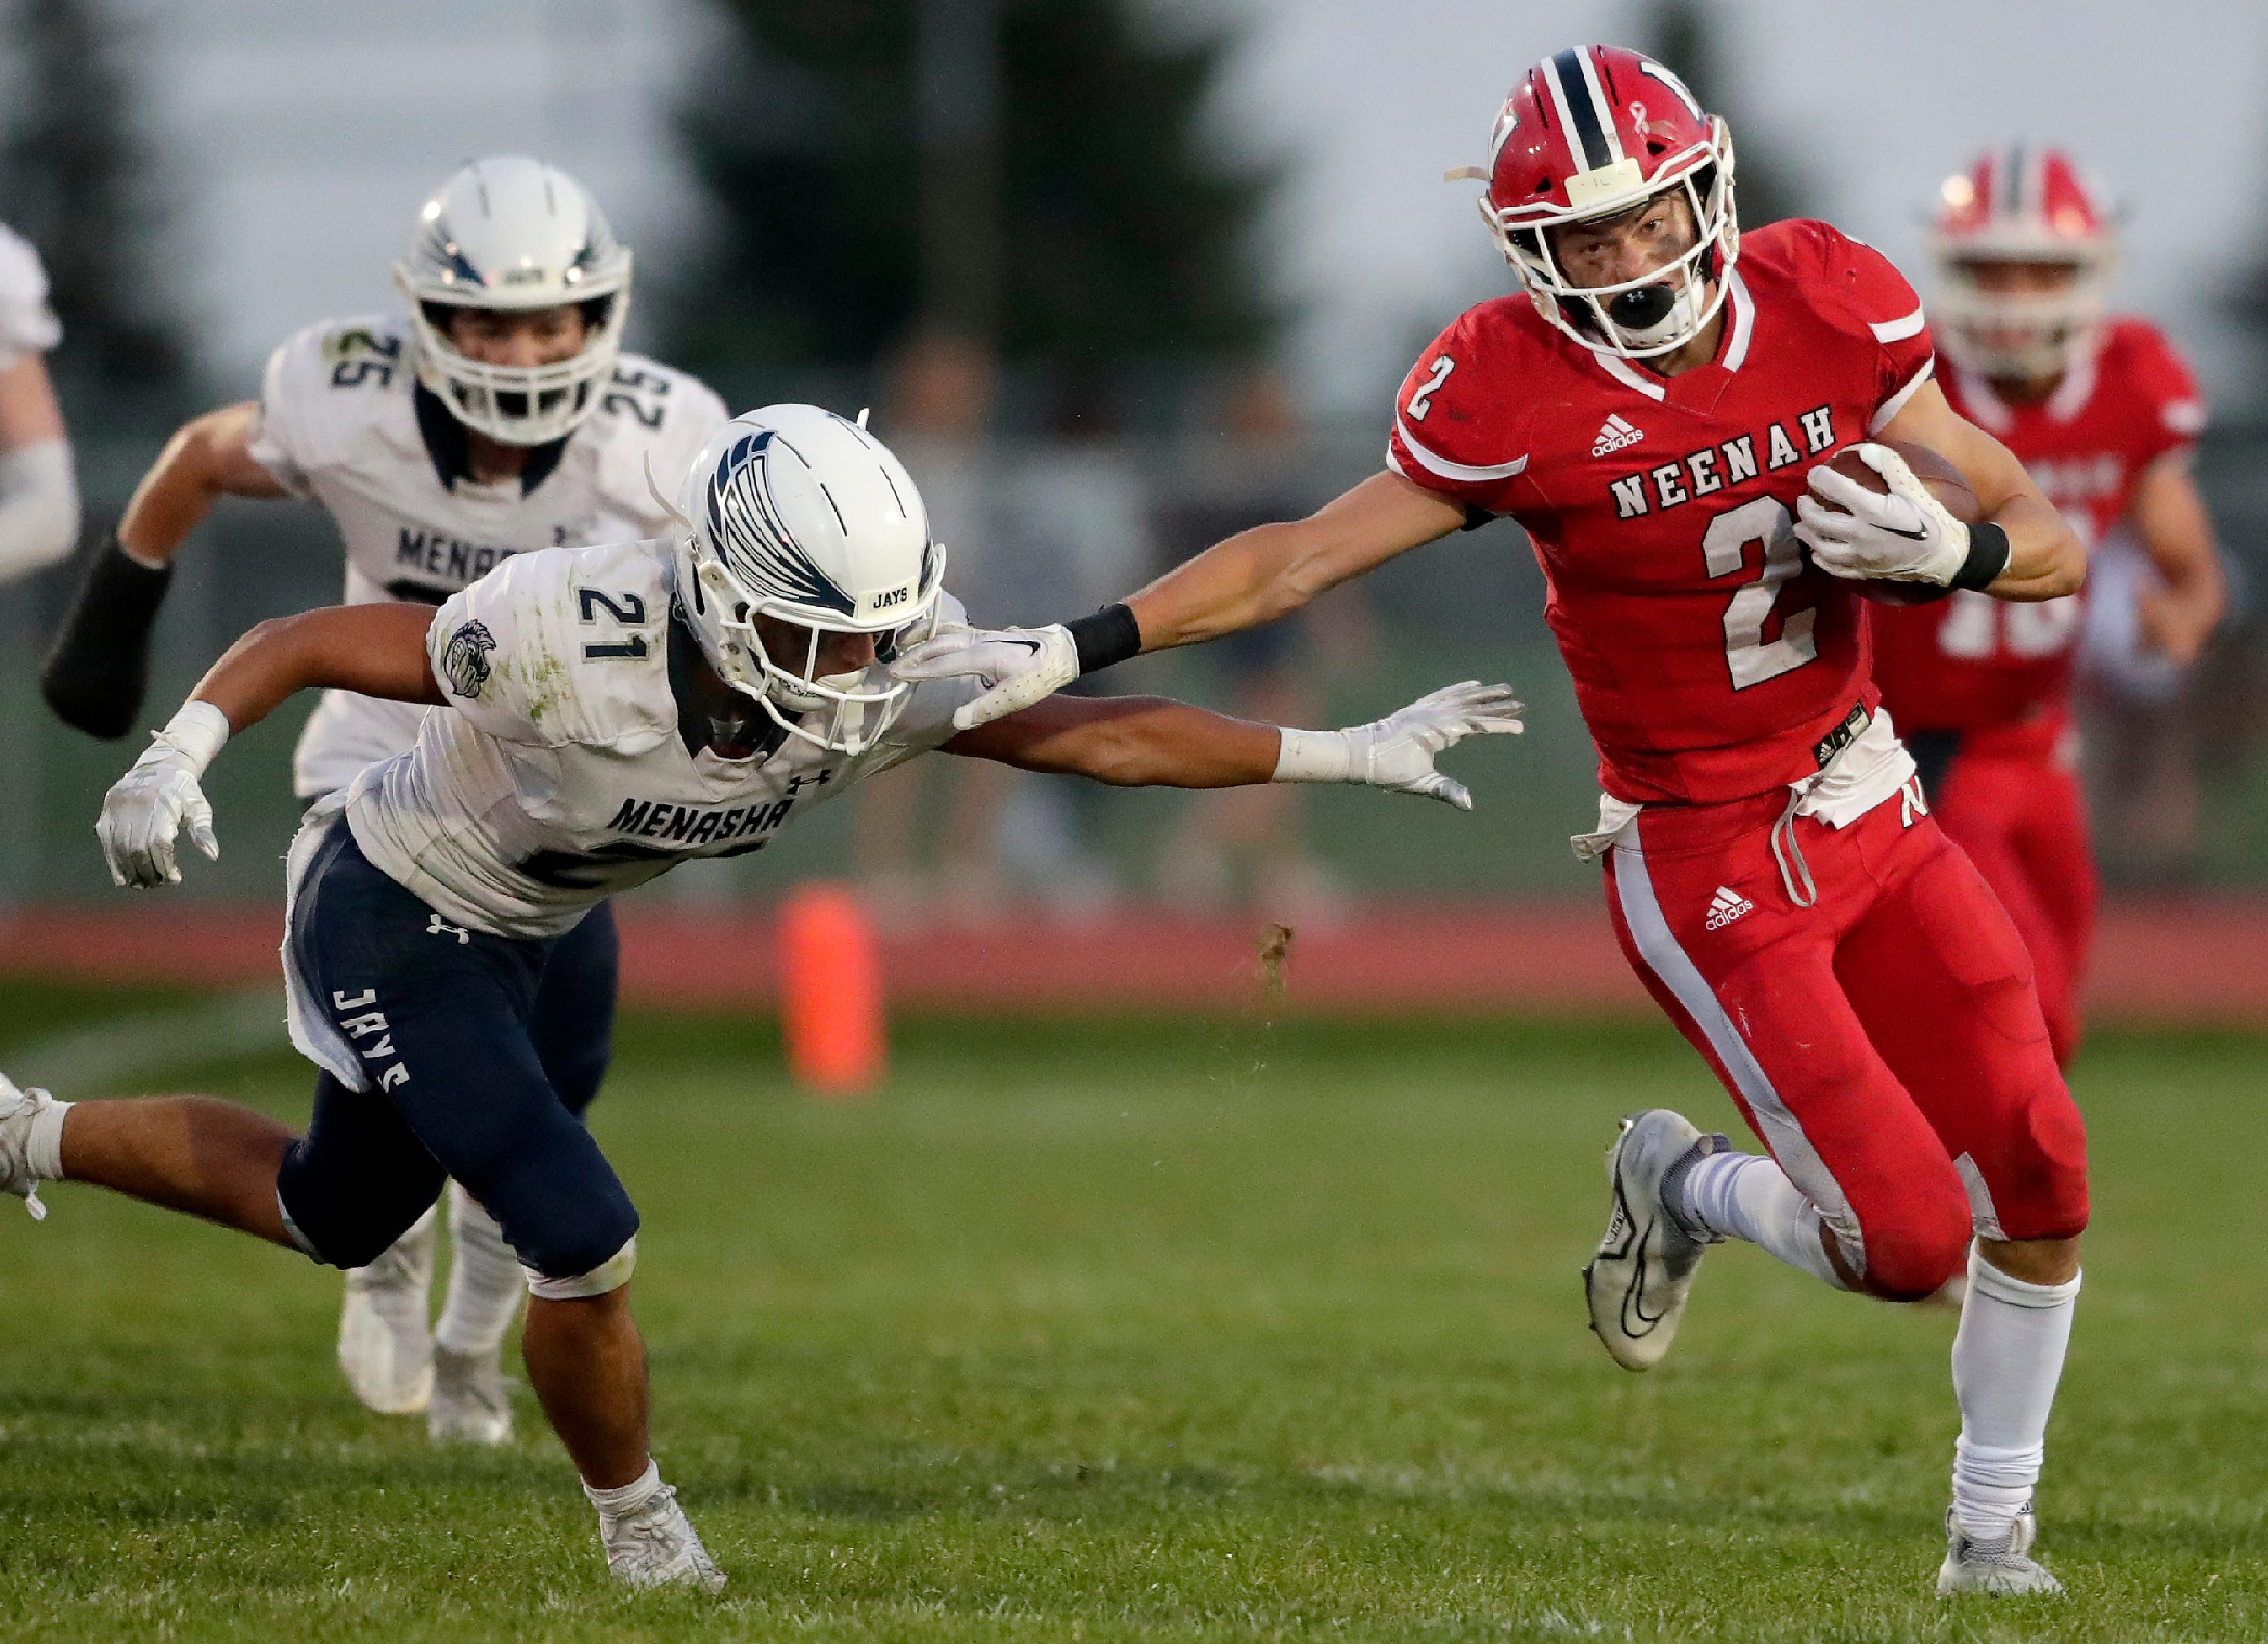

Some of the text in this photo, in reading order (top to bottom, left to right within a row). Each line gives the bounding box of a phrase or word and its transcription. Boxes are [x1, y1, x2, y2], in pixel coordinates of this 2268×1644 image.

[1407, 354, 1455, 421] 2
[1591, 429, 1644, 458] adidas
[1610, 405, 1835, 519] NEENAH
[873, 587, 907, 609] JAYS
[1702, 495, 1816, 692] 2
[578, 587, 649, 663] 21
[609, 798, 794, 844] MENASHA
[1706, 900, 1753, 930] adidas
